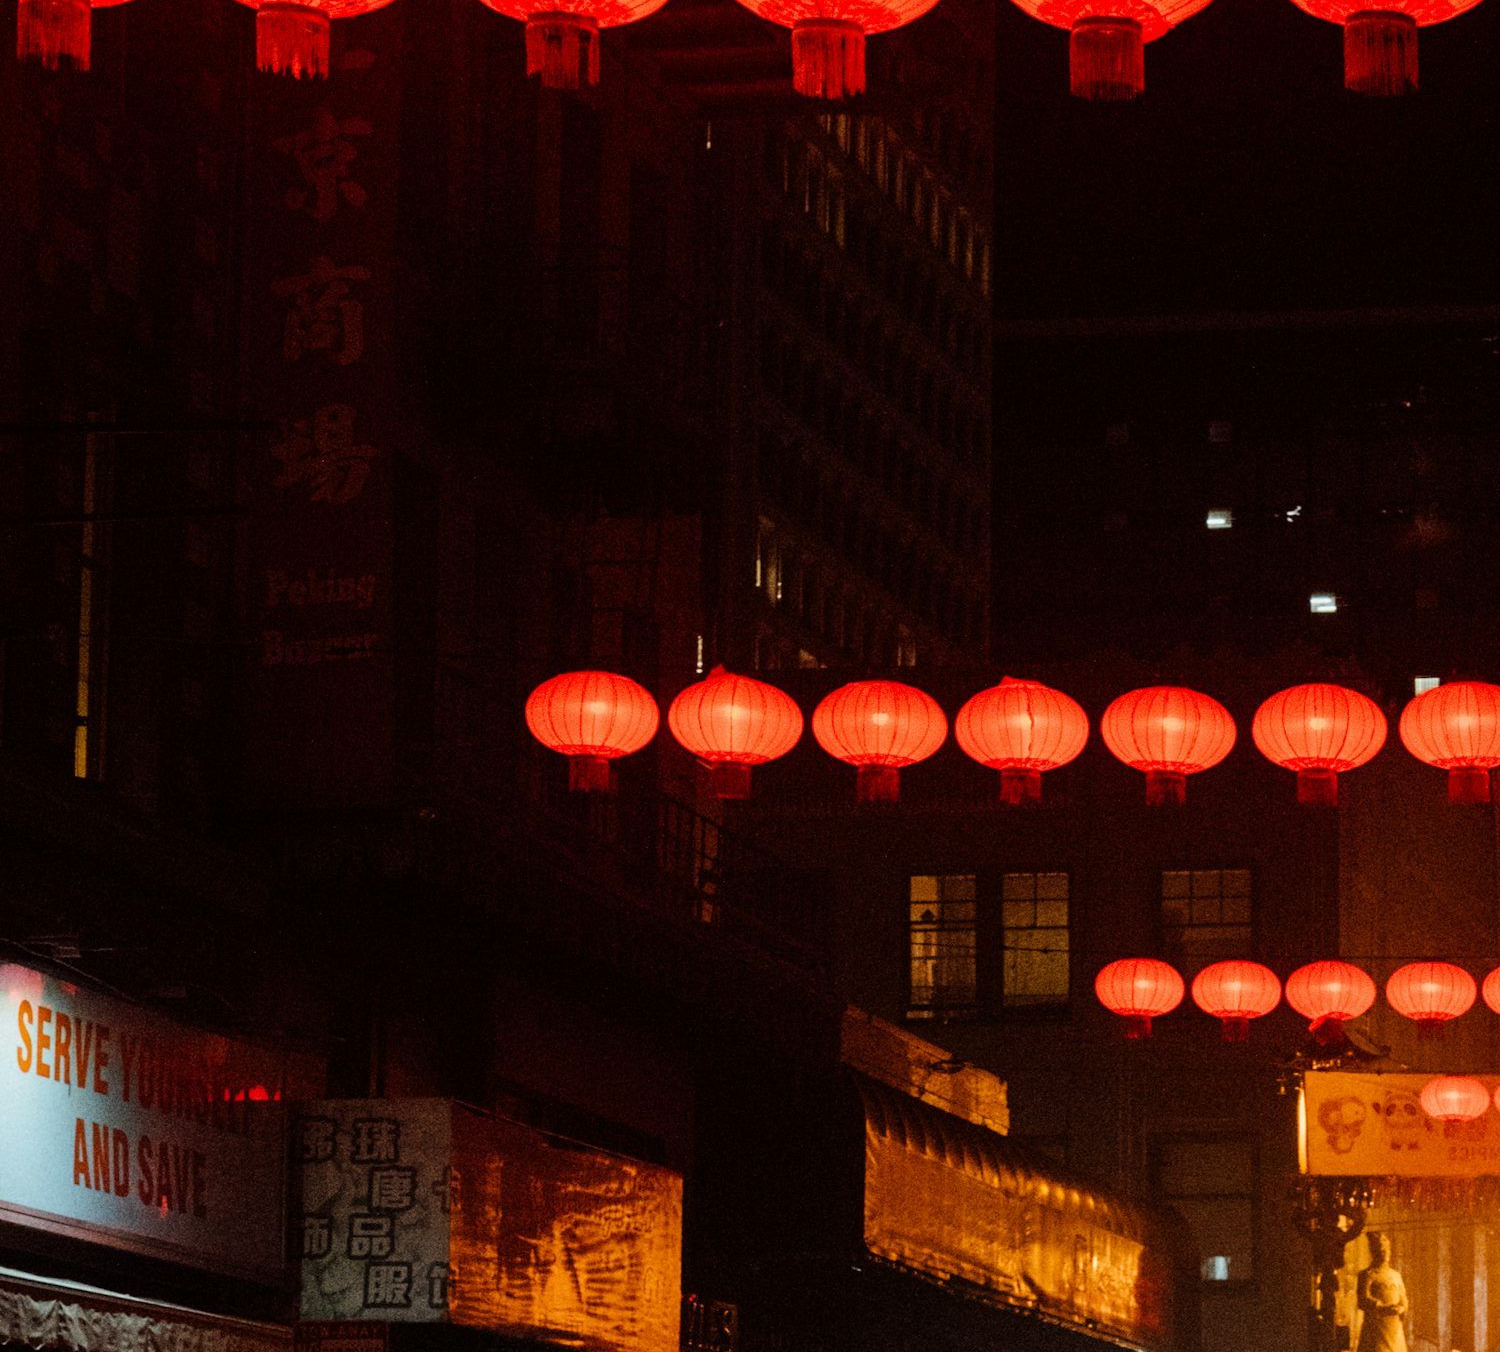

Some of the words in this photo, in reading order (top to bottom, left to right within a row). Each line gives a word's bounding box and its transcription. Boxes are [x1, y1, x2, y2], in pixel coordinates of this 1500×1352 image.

[271, 47, 373, 506] 京商場
[17, 1000, 110, 1095] SERVE
[73, 1118, 129, 1197] AND
[138, 1135, 207, 1219] SAVE
